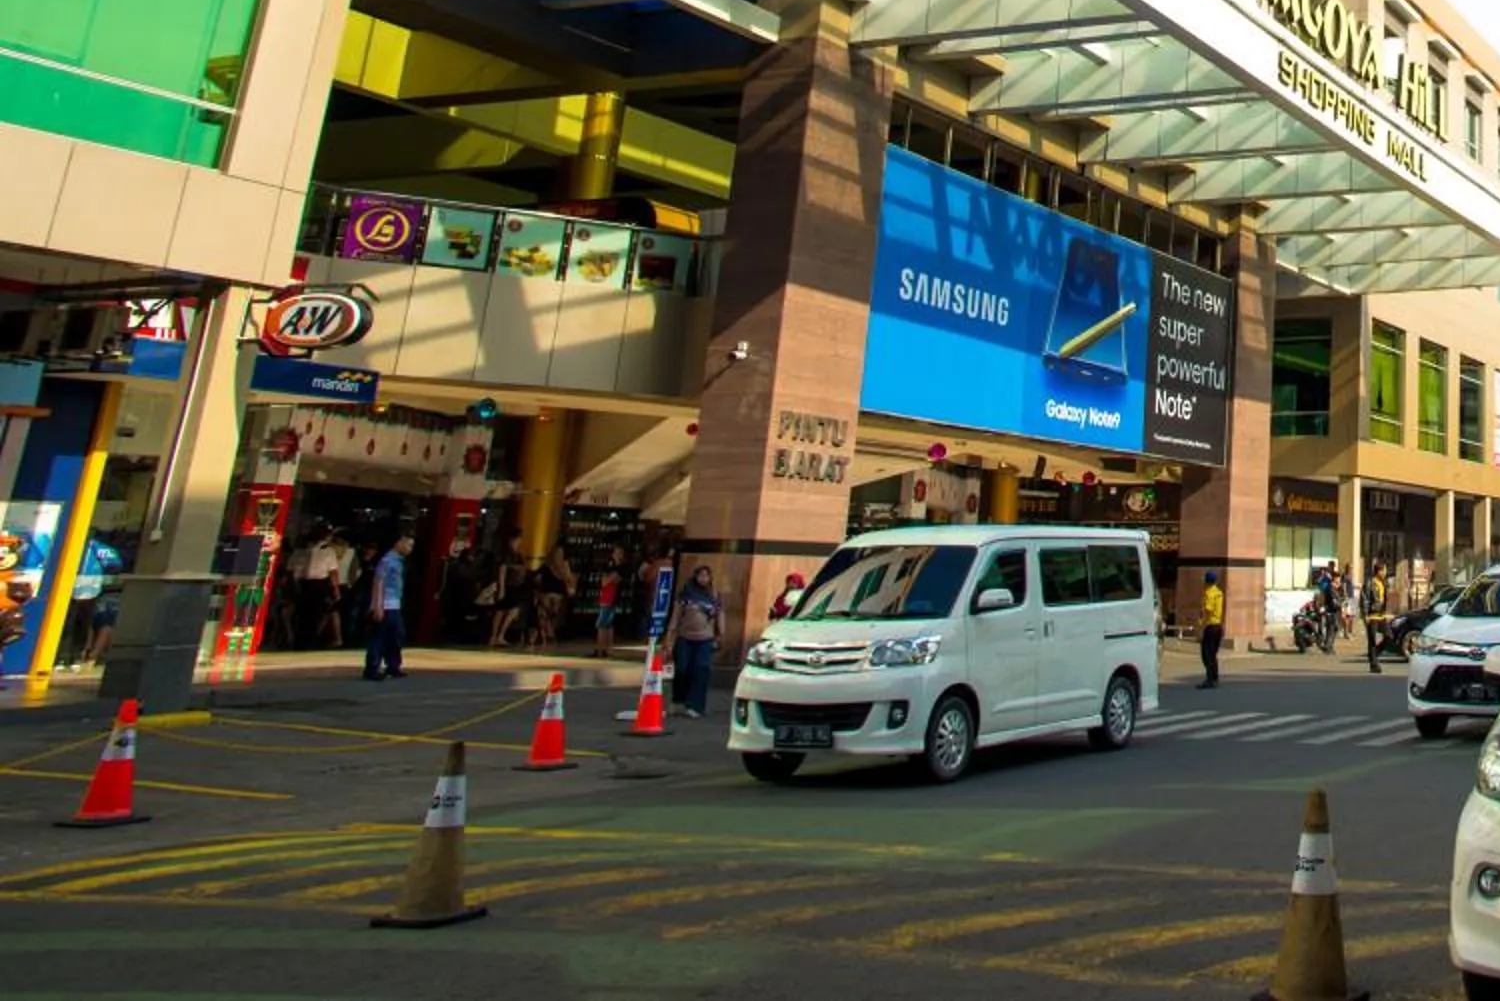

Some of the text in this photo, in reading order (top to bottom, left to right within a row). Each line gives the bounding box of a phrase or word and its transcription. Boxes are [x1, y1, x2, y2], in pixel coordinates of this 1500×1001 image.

[1277, 49, 1428, 183] SHOPPING MALL
[899, 266, 1010, 327] SAMSUNG
[1162, 272, 1227, 318] The new
[1158, 315, 1205, 350] super
[1156, 353, 1226, 392] powerful
[776, 409, 849, 448] PINTU
[1045, 399, 1088, 429] Galaxy
[771, 448, 850, 485] BARAT
